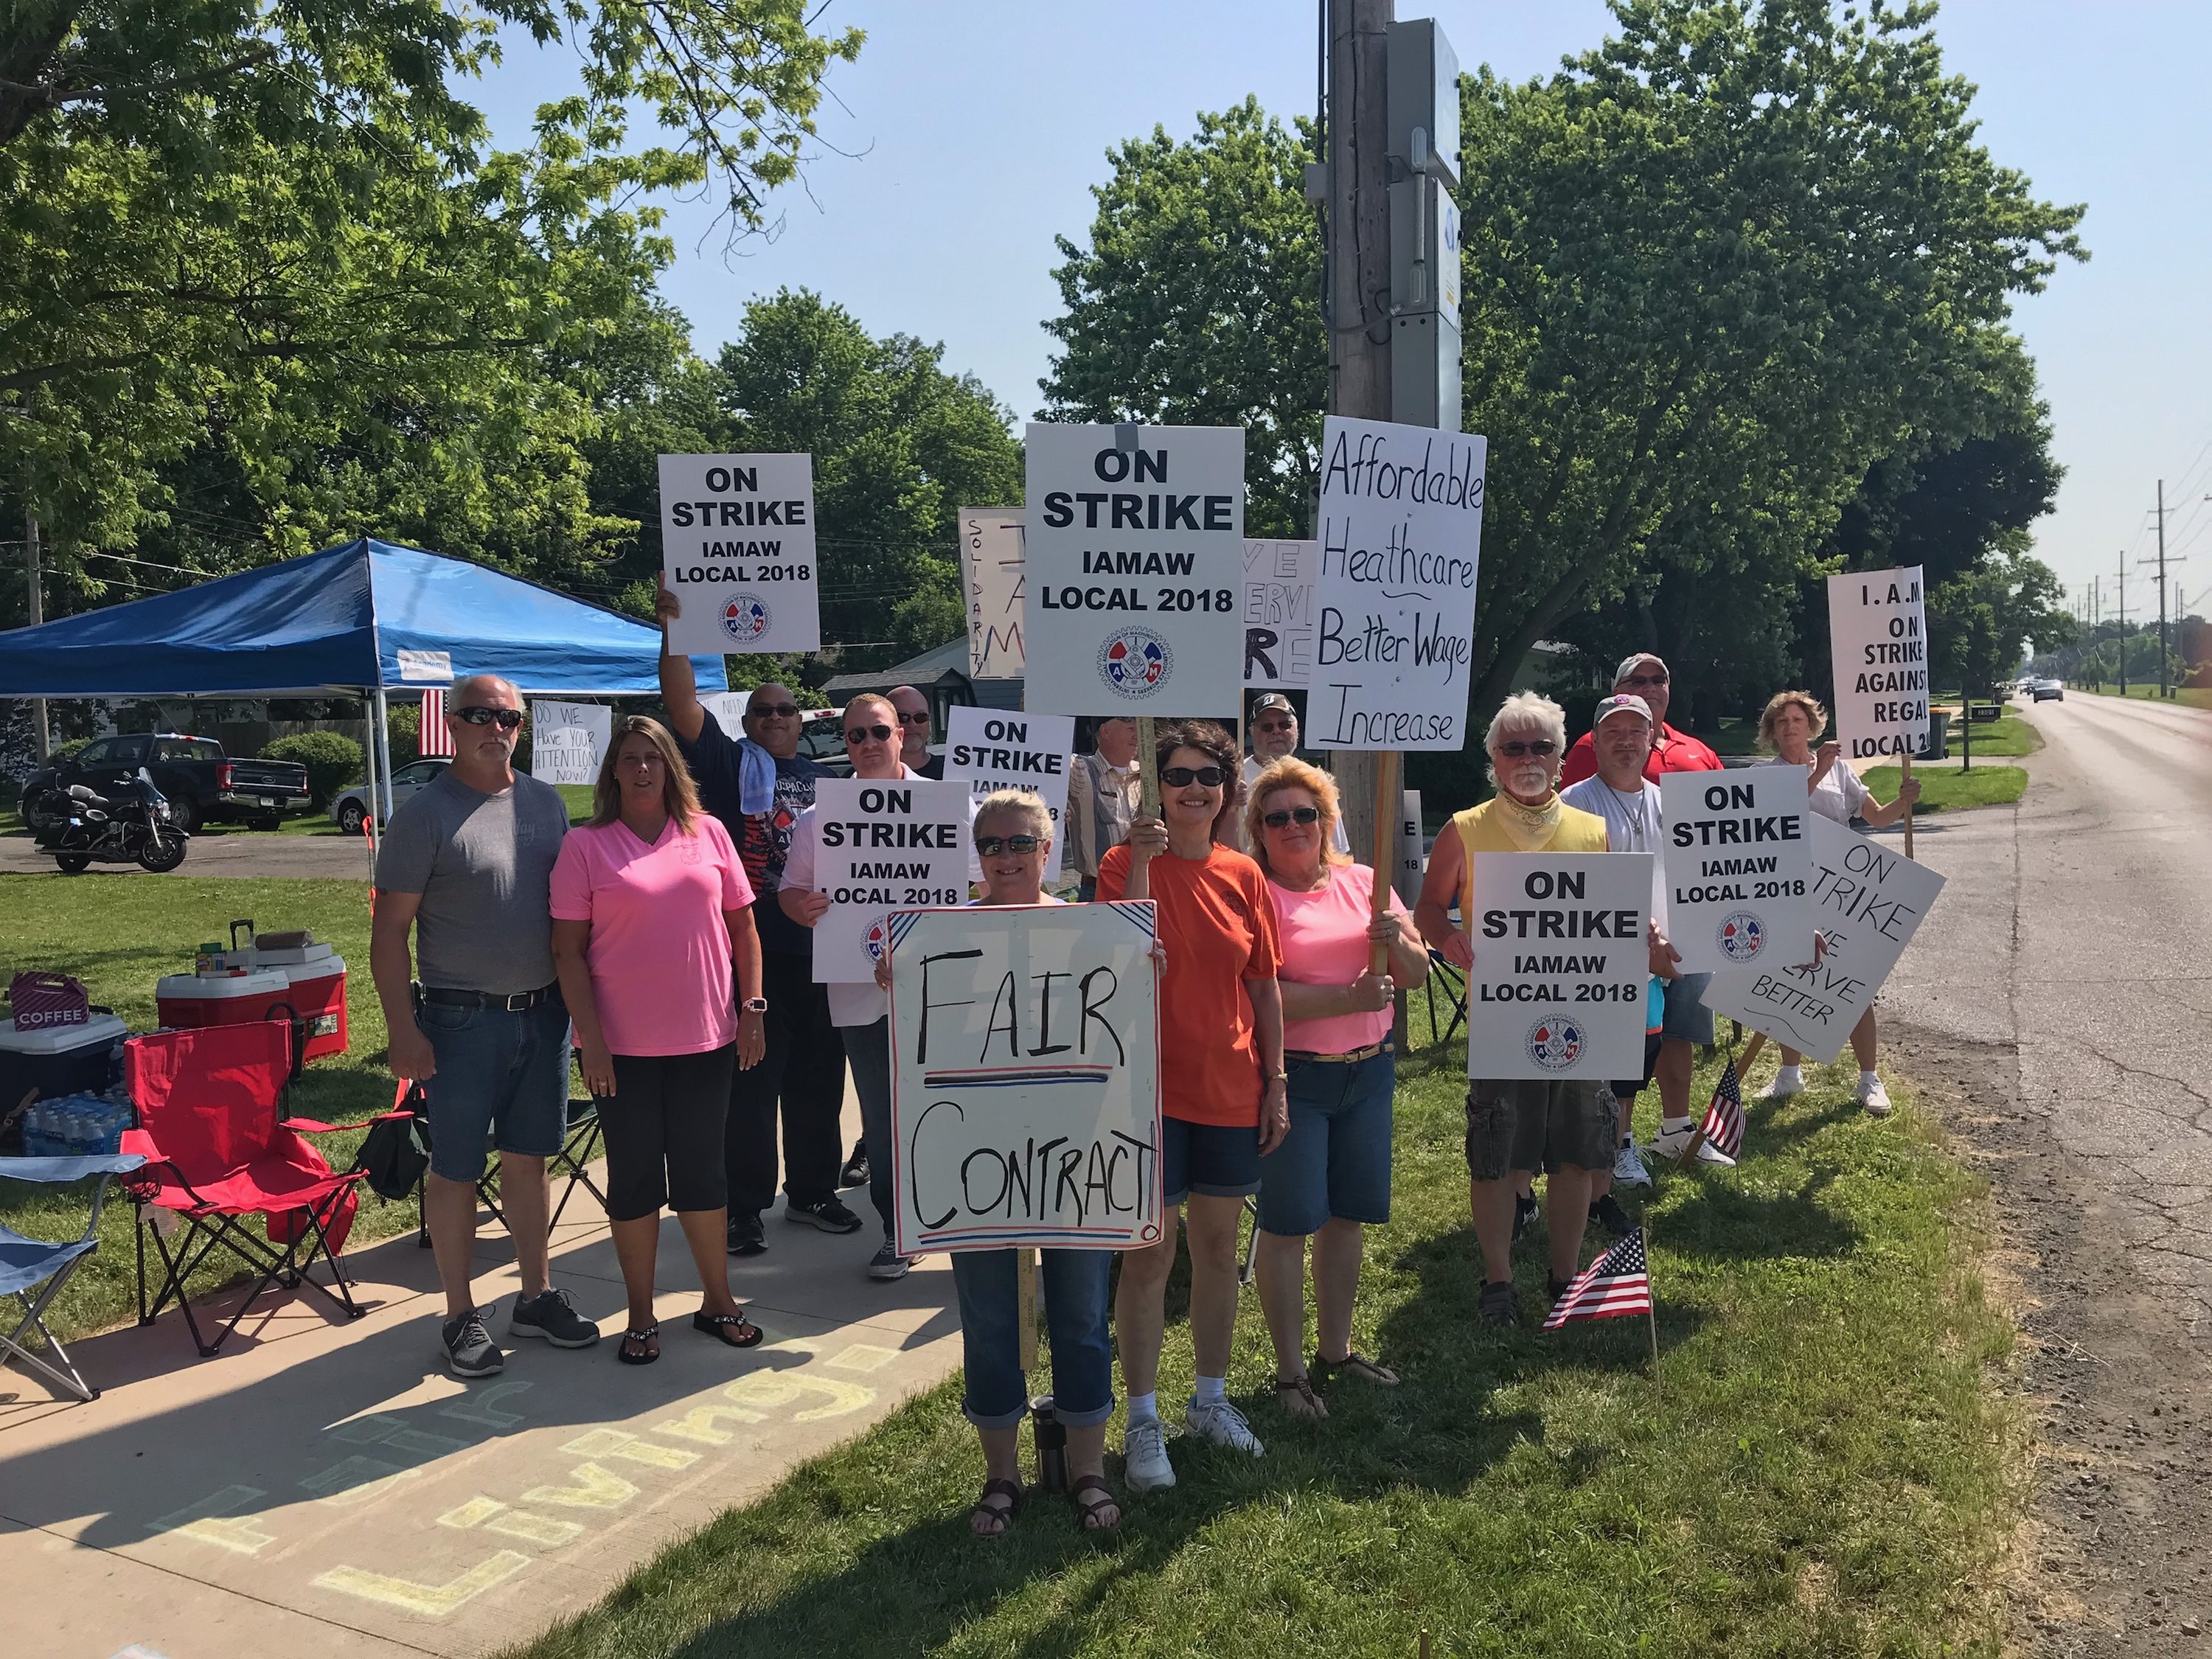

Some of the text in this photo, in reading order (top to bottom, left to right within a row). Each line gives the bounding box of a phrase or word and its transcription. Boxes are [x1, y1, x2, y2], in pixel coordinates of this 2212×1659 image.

[1095, 448, 1168, 483] ON
[1323, 430, 1484, 509] Affordable
[706, 467, 758, 492] ON
[672, 501, 806, 526] STRIKE
[1043, 492, 1233, 531] STRIKE
[702, 540, 782, 558] IAMAW
[1323, 522, 1475, 586] Heathcare
[675, 564, 810, 583] LOCAL 2018
[1083, 551, 1195, 576] IAMAW
[1042, 586, 1233, 613] LOCAL 2018
[1889, 616, 1918, 638] ON
[1318, 608, 1470, 686] Better Wage
[1865, 641, 1922, 664] STRIKE
[1150, 667, 1158, 677] M
[1855, 669, 1927, 693] AGAINST
[535, 701, 583, 724] DO WE
[1320, 684, 1453, 744] Increase
[1874, 700, 1927, 723] REGAL
[537, 728, 562, 746] Have
[984, 720, 1028, 743] ON
[1852, 734, 1915, 759] LOCAL
[535, 749, 599, 770] ATTENTION
[952, 745, 1062, 775] STRIKE
[556, 768, 588, 782] NOW?
[859, 788, 911, 814] ON
[1704, 784, 1755, 810] ON
[821, 821, 957, 849] STRIKE
[1672, 815, 1801, 847] STRIKE
[850, 862, 931, 880] IAMAW
[1702, 856, 1778, 877] IAMAW
[1845, 845, 1896, 884] ON
[821, 887, 958, 905] OCAL 2018
[1524, 871, 1585, 900] ON
[1676, 880, 1806, 904] LOCAL 2018
[1812, 862, 1916, 942] TRIKE
[1482, 910, 1638, 939] STRIKE
[1514, 956, 1607, 974] IAMAW
[1481, 984, 1638, 1002] LOCAL 2018
[1751, 974, 1834, 1026] BETTER
[19, 1009, 83, 1024] COFFEE
[917, 949, 1124, 1066] FAIR
